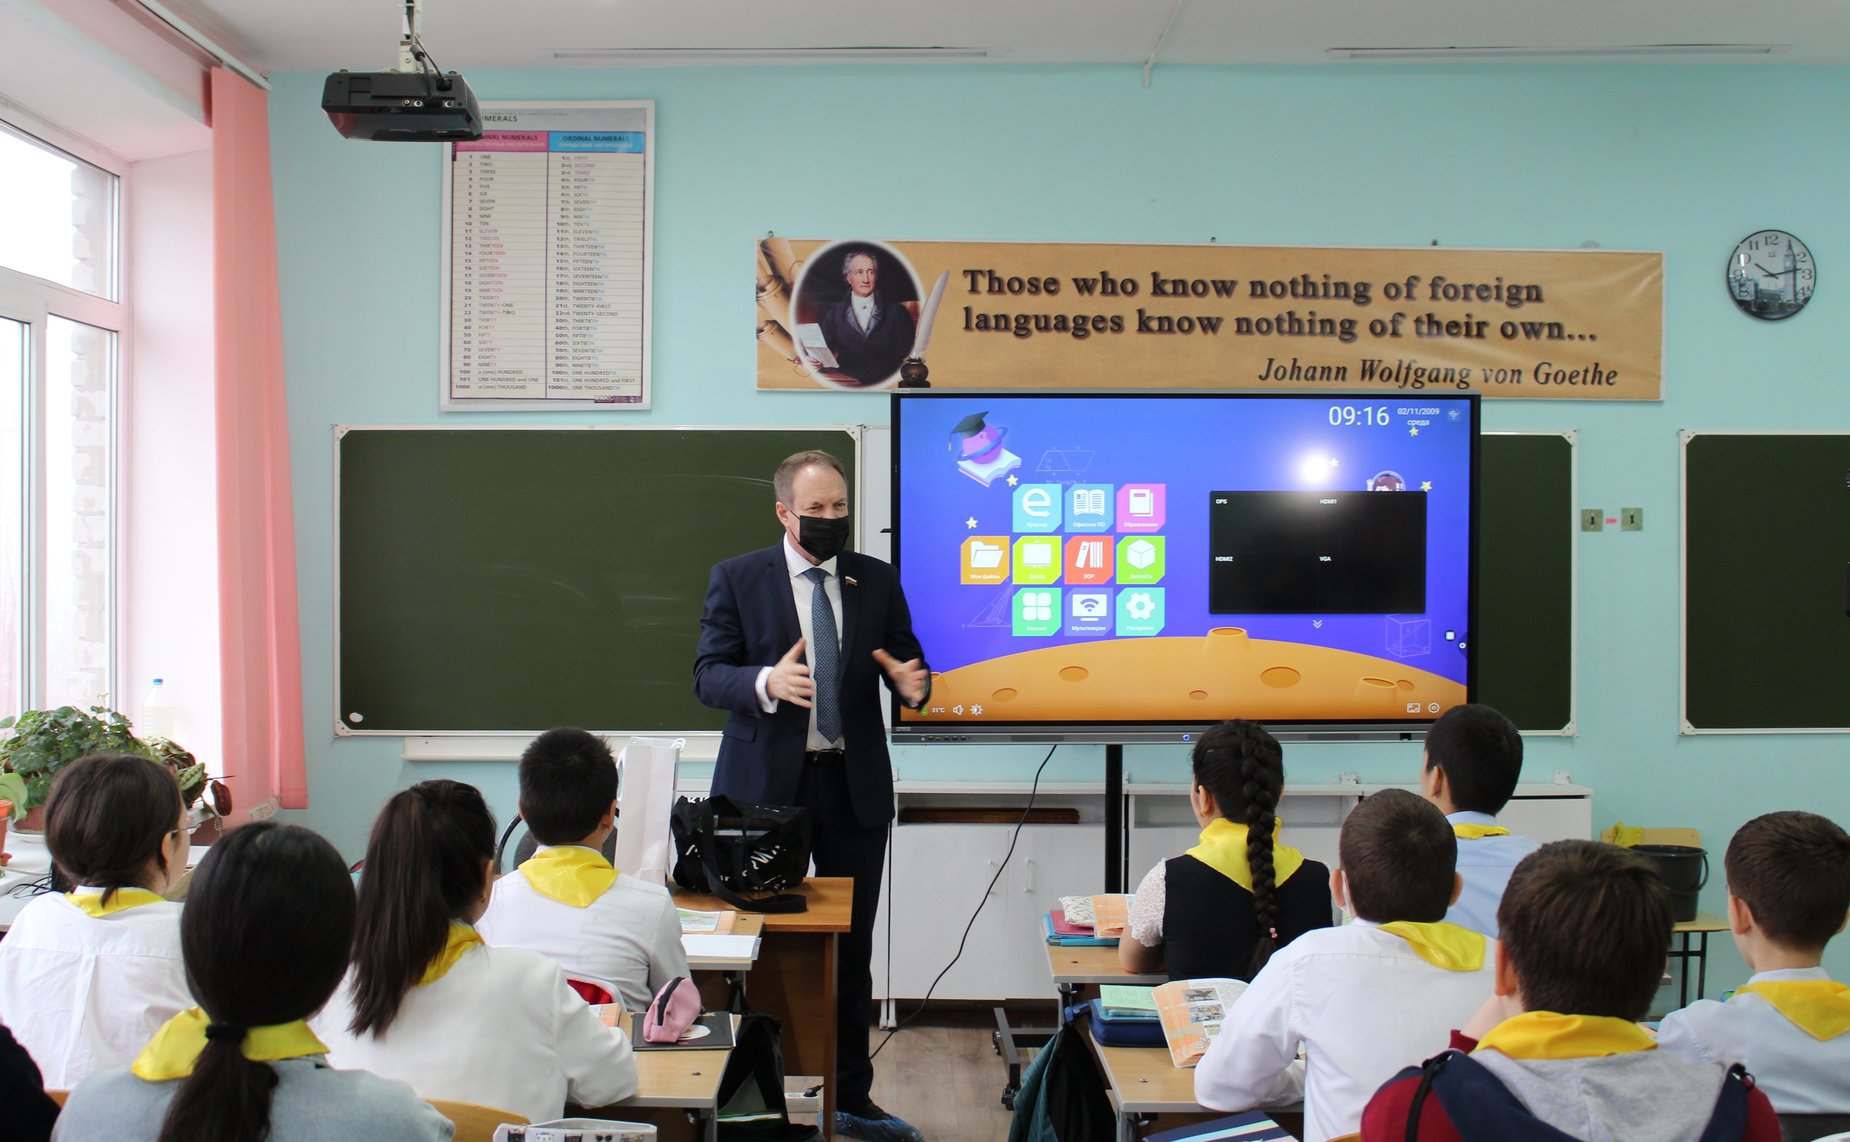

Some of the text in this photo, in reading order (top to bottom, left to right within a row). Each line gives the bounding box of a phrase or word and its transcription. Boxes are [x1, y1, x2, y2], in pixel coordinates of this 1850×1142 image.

[1749, 241, 1759, 251] 11
[1764, 235, 1779, 246] 12
[1797, 252, 1807, 263] 2
[1802, 269, 1812, 280] 3
[962, 269, 1544, 307] Those who know nothing of foreign
[962, 307, 1597, 343] languages know nothing of their own...
[1258, 357, 1618, 389] Johann Wolfgang von Goethe
[1328, 406, 1390, 426] 09:16
[1397, 407, 1440, 415] 02/11/2009
